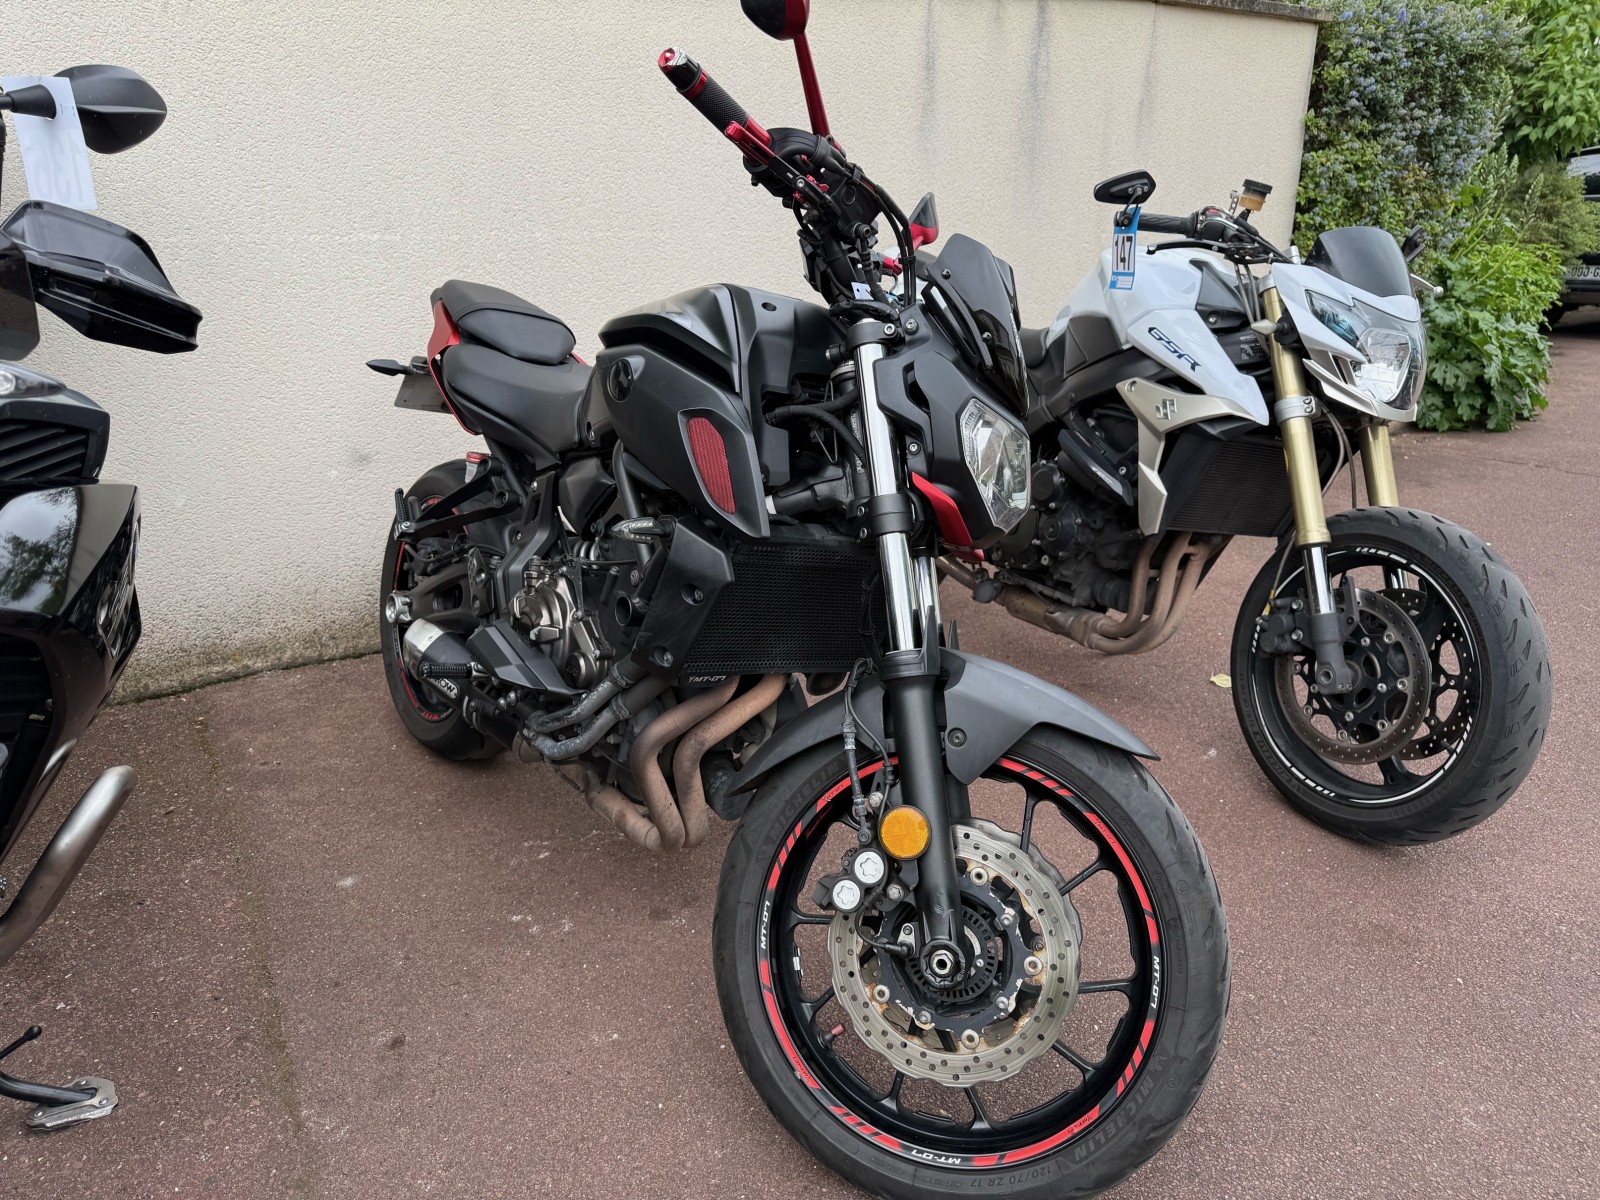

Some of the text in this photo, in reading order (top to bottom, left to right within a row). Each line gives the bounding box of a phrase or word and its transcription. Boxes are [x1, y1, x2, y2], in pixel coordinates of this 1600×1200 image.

[1114, 234, 1133, 272] 147
[1148, 326, 1202, 372] GSR
[760, 900, 771, 950] MT-07
[1150, 955, 1160, 1009] MT-07
[1074, 1075, 1155, 1161] MICHELIN
[911, 1149, 961, 1165] MT-07
[1009, 1163, 1052, 1185] 120/70
[970, 1178, 982, 1188] 17
[988, 1176, 1003, 1187] ZR
